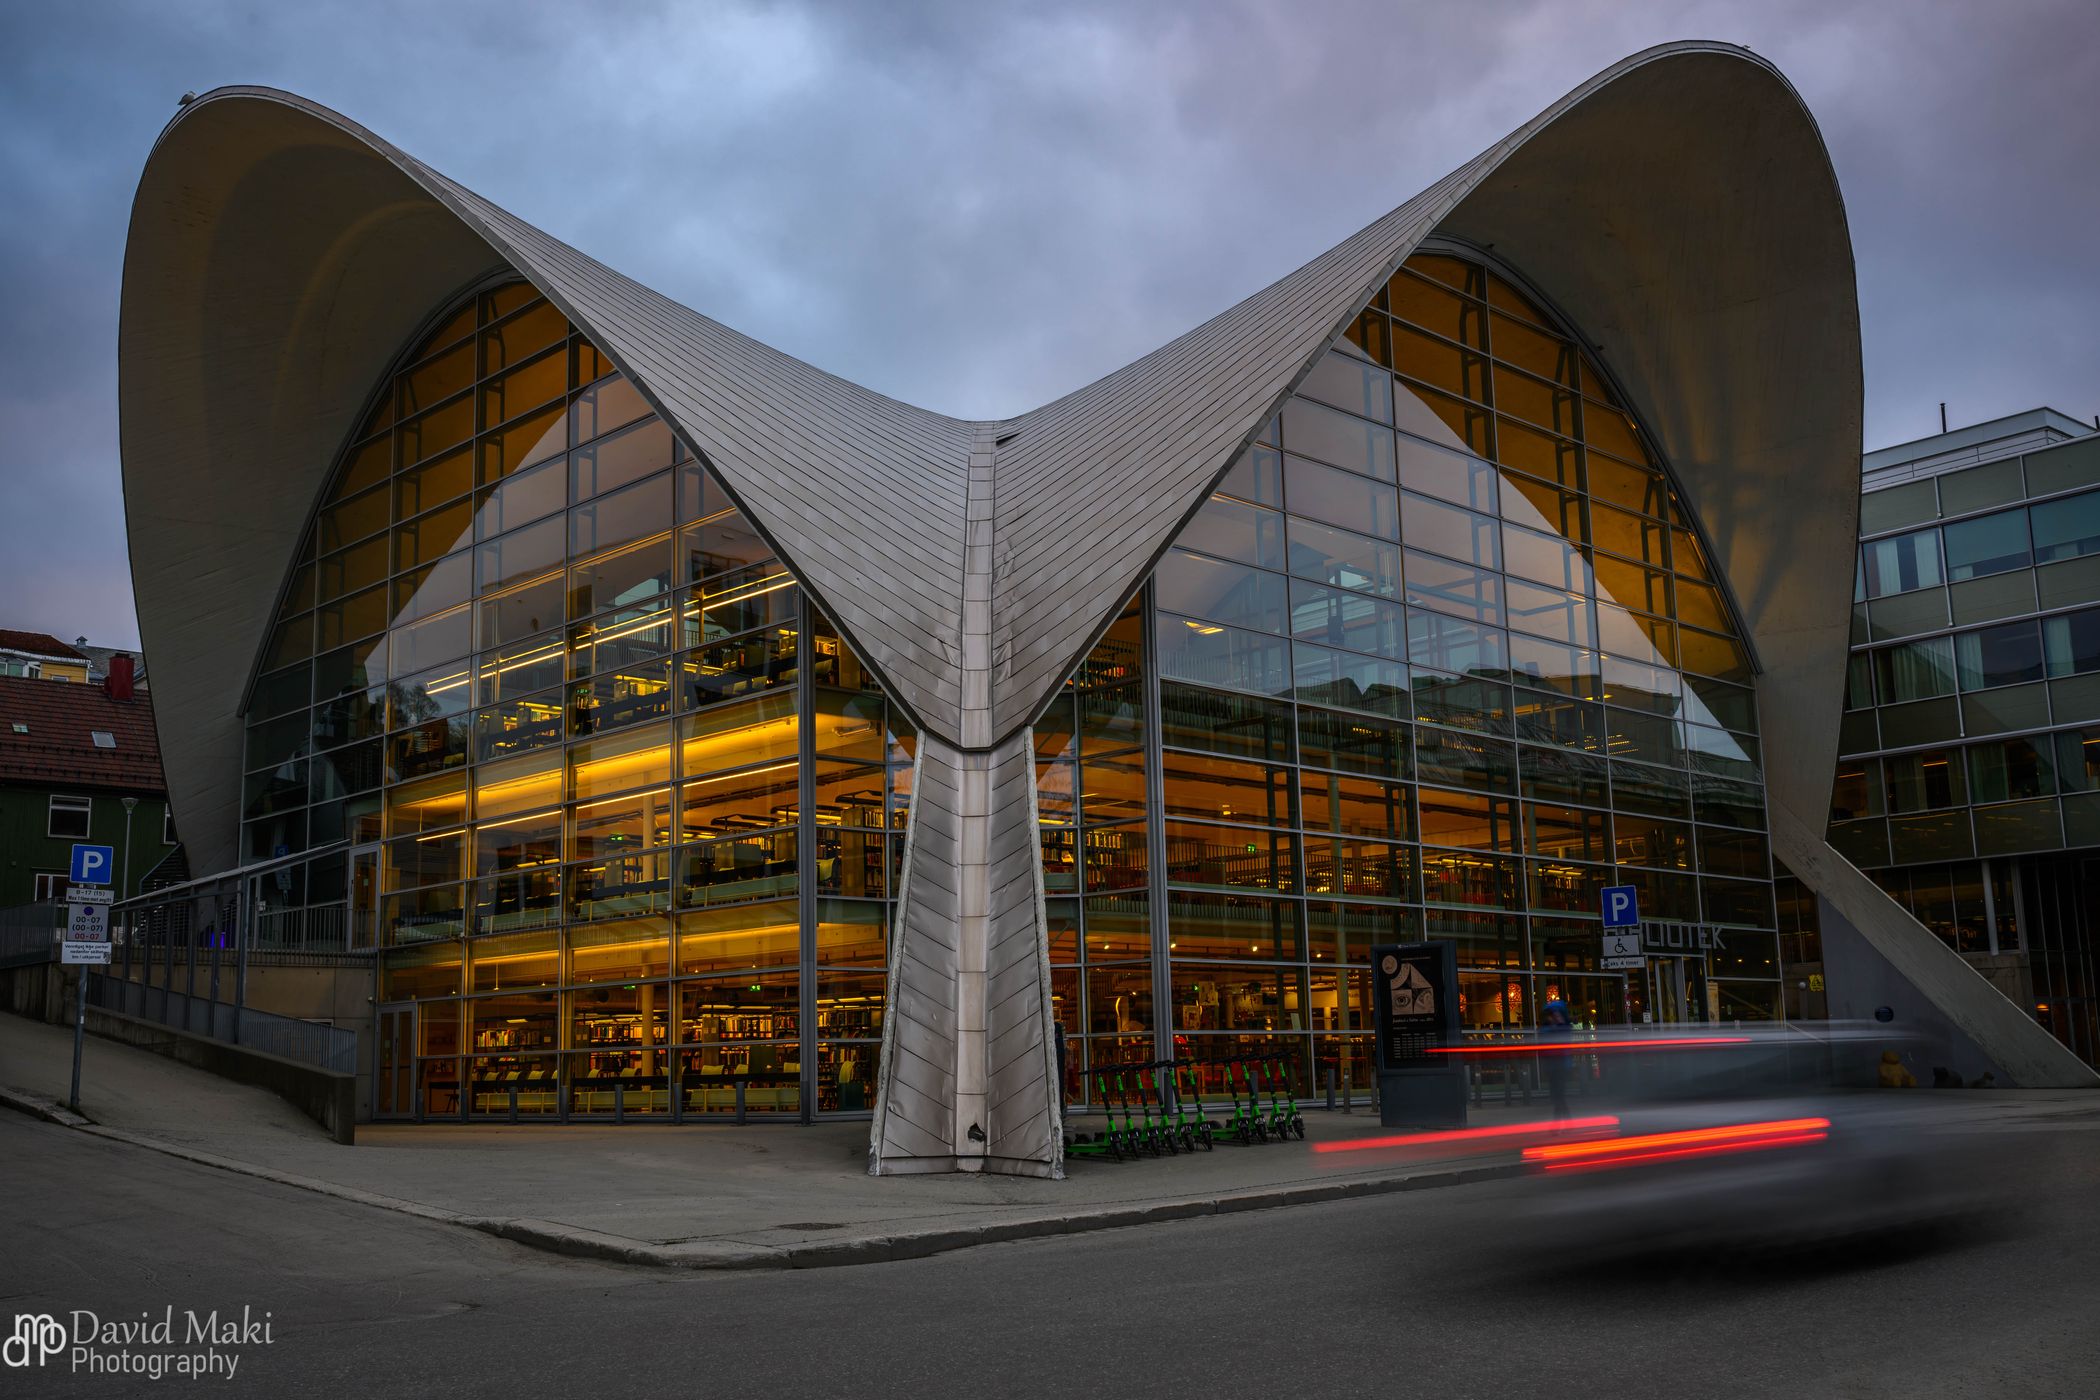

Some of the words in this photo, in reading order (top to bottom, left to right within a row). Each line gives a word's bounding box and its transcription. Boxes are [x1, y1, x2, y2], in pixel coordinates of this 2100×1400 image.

[82, 851, 104, 878] P
[1611, 893, 1629, 921] P
[72, 924, 103, 932] (00-07)
